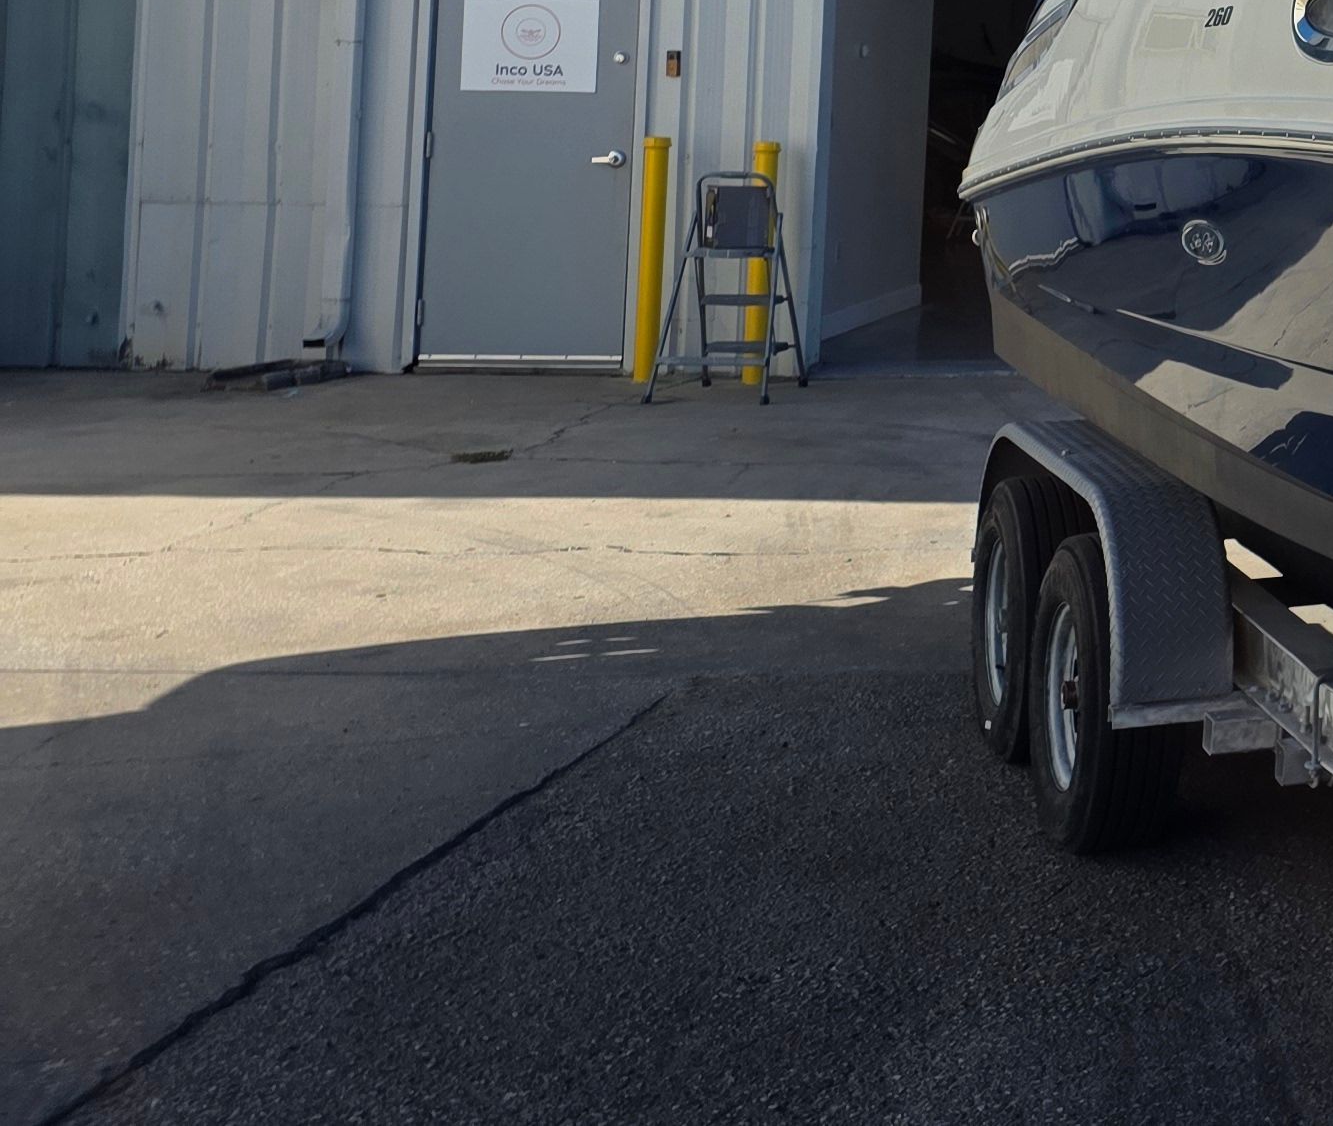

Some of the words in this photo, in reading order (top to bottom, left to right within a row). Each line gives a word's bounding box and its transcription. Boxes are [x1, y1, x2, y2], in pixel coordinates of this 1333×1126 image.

[1204, 5, 1234, 28] 260
[495, 63, 528, 76] Inco
[533, 64, 564, 77] USA
